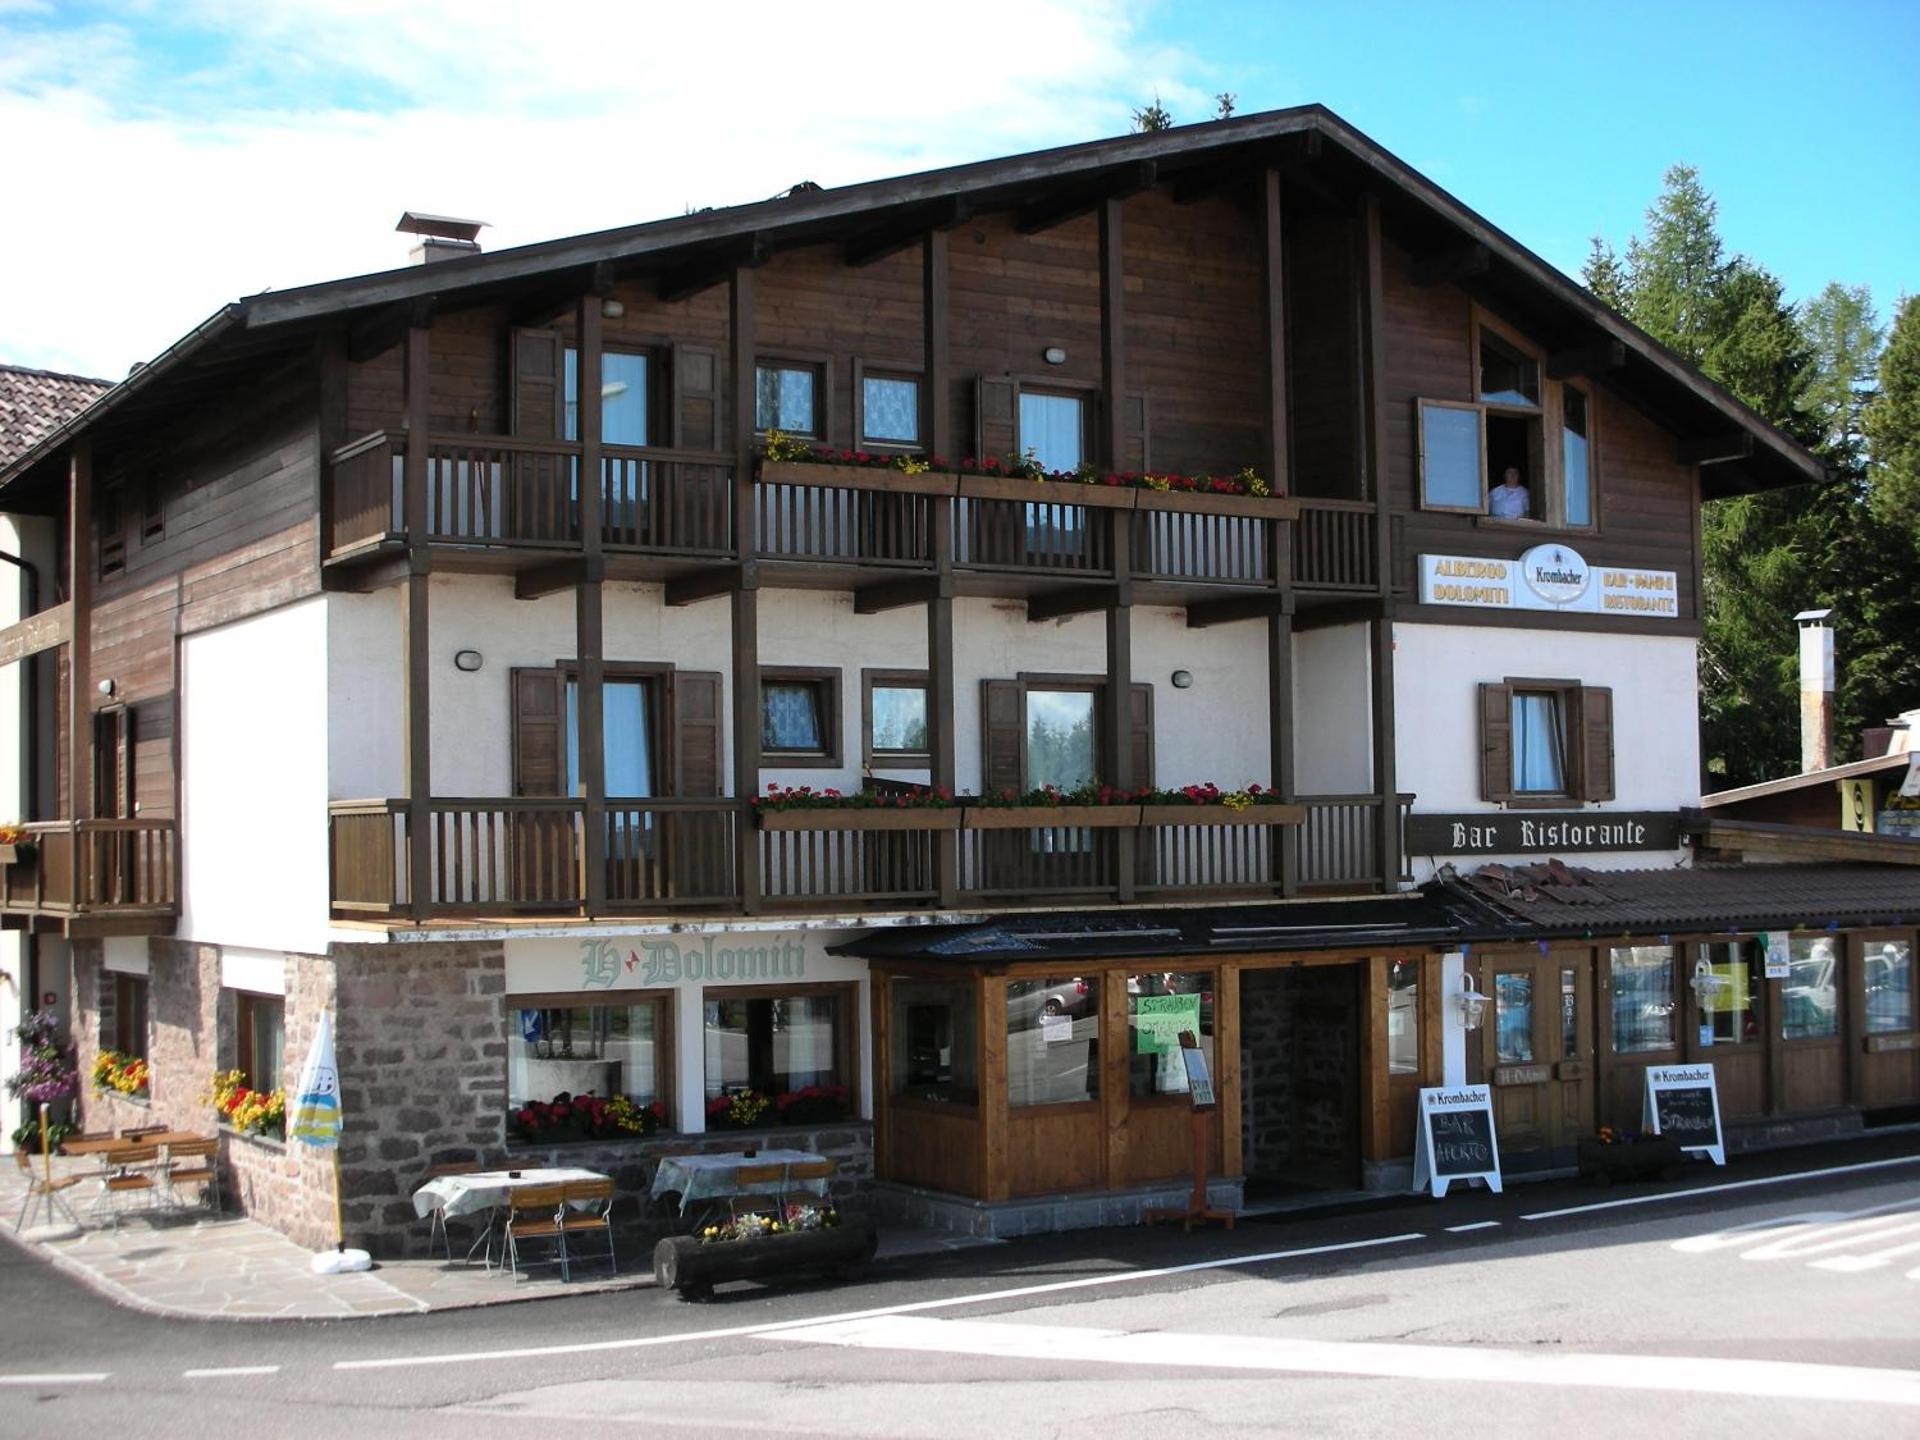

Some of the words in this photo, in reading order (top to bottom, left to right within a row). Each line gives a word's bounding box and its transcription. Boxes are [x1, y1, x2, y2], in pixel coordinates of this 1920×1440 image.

[1536, 566, 1582, 585] Krombacher
[1433, 583, 1509, 605] DOLOMITI
[1452, 822, 1497, 848] Bar
[1520, 819, 1646, 847] Ristorante
[641, 934, 806, 987] Dolomiti
[1662, 1070, 1710, 1082] Krombacher
[1437, 1091, 1487, 1105] Krombacher
